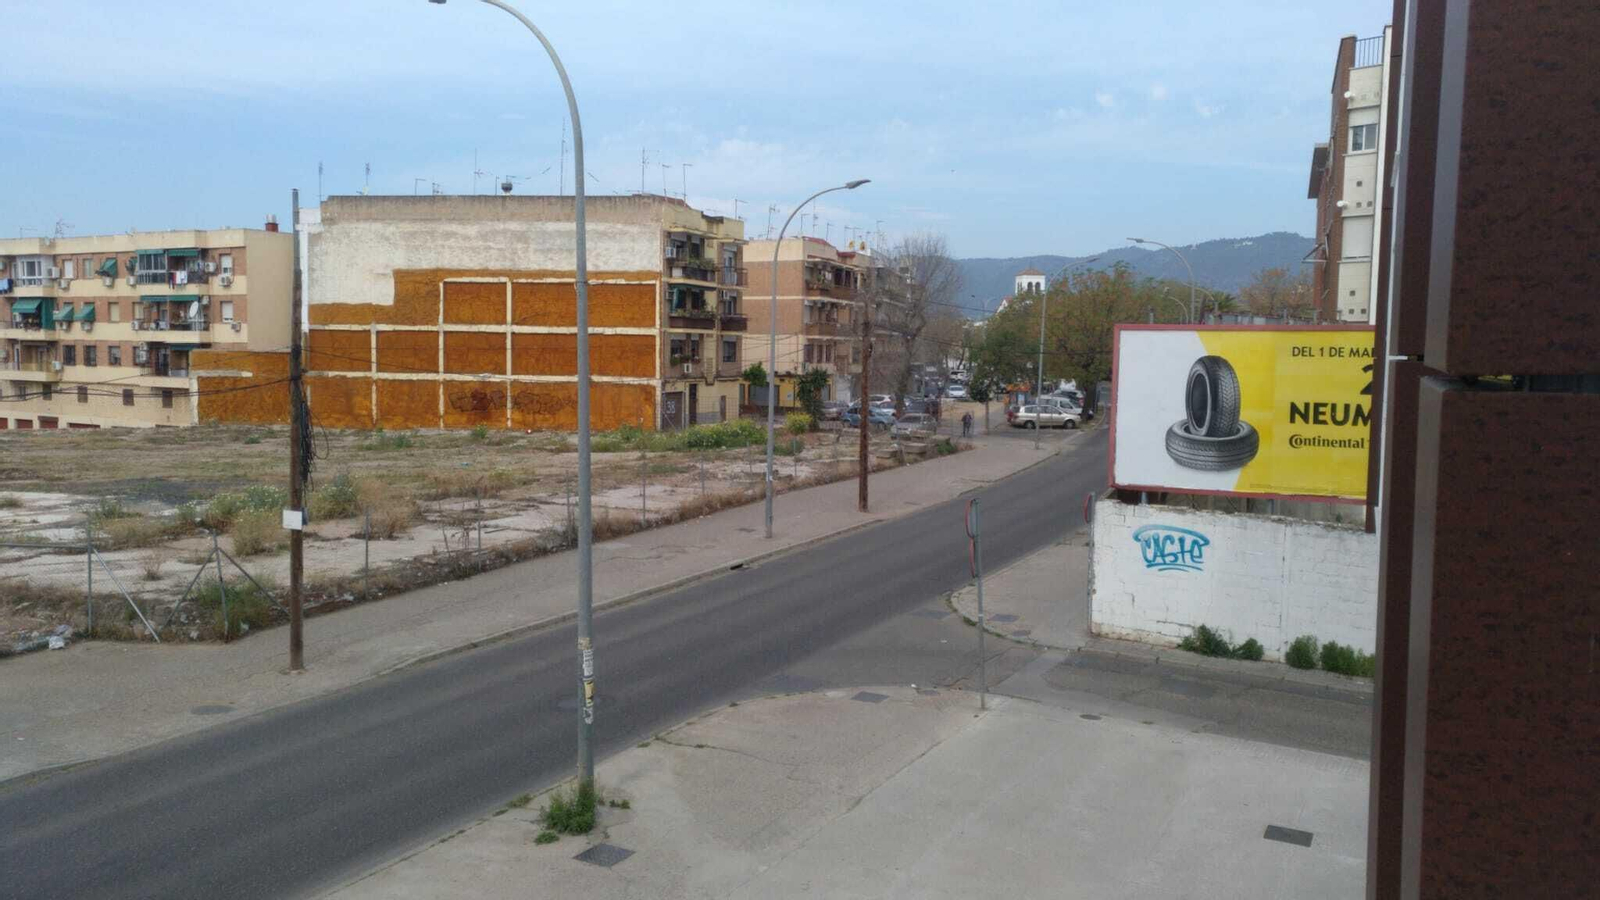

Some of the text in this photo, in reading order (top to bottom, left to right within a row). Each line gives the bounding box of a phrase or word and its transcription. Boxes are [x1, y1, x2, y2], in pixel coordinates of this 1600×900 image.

[1292, 346, 1315, 357] DEL
[1319, 347, 1325, 357] 1
[1329, 347, 1345, 357] DE
[1289, 433, 1365, 449] Continental
